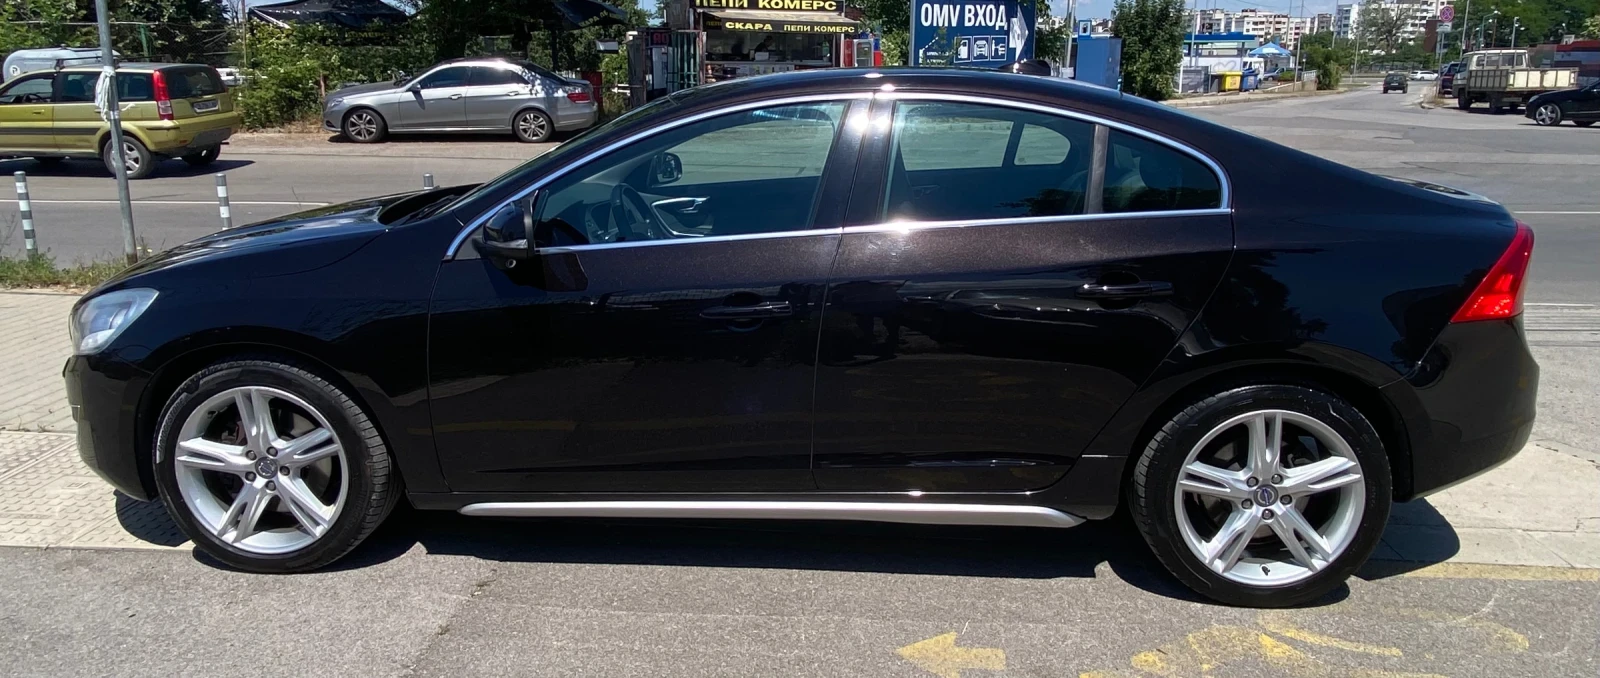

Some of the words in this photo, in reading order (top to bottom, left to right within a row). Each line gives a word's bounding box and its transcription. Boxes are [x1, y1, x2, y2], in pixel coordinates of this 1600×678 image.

[758, 0, 837, 11] КОМЕРС
[920, 3, 960, 27] OMV
[964, 4, 1008, 31] ВХОД
[725, 21, 773, 31] СКАРА
[784, 24, 811, 32] ПЕПИ
